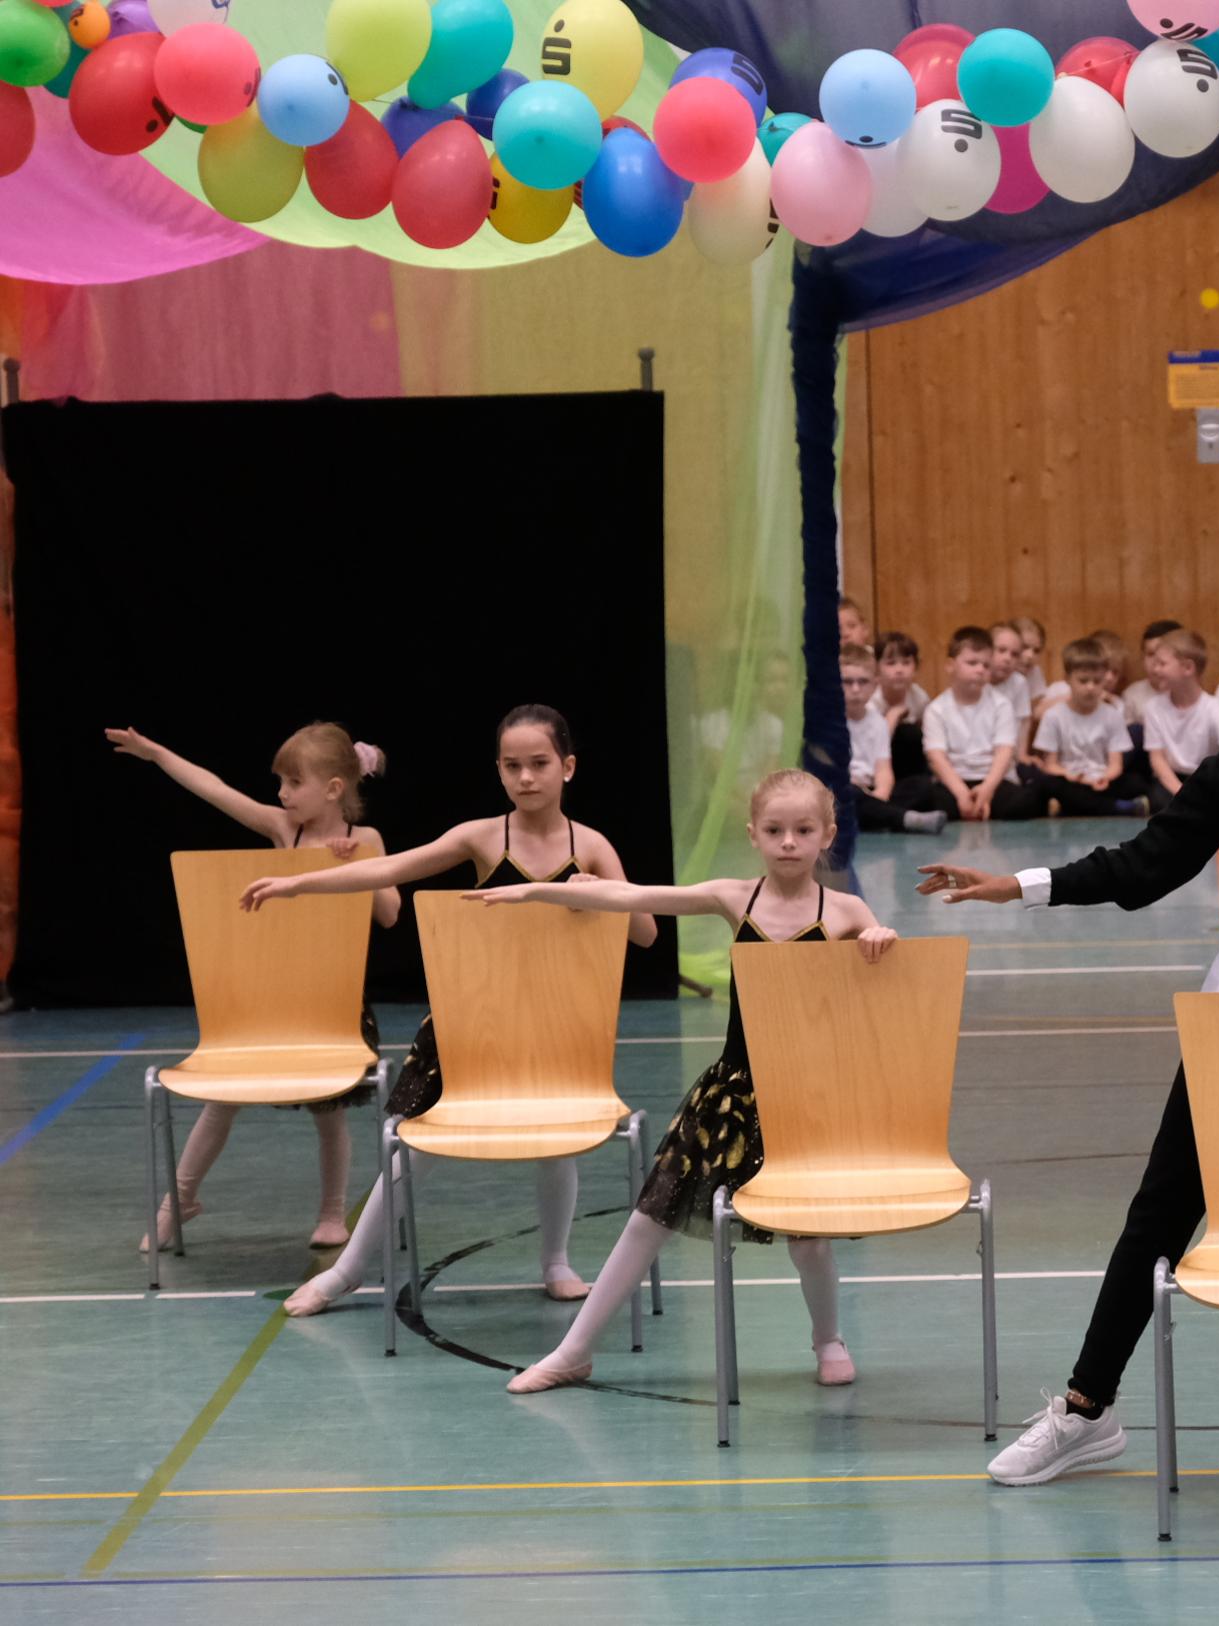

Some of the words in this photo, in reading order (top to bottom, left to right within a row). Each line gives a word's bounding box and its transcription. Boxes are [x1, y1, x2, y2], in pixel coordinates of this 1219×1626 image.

[542, 37, 571, 76] S
[1176, 48, 1218, 80] S
[941, 109, 983, 139] S
